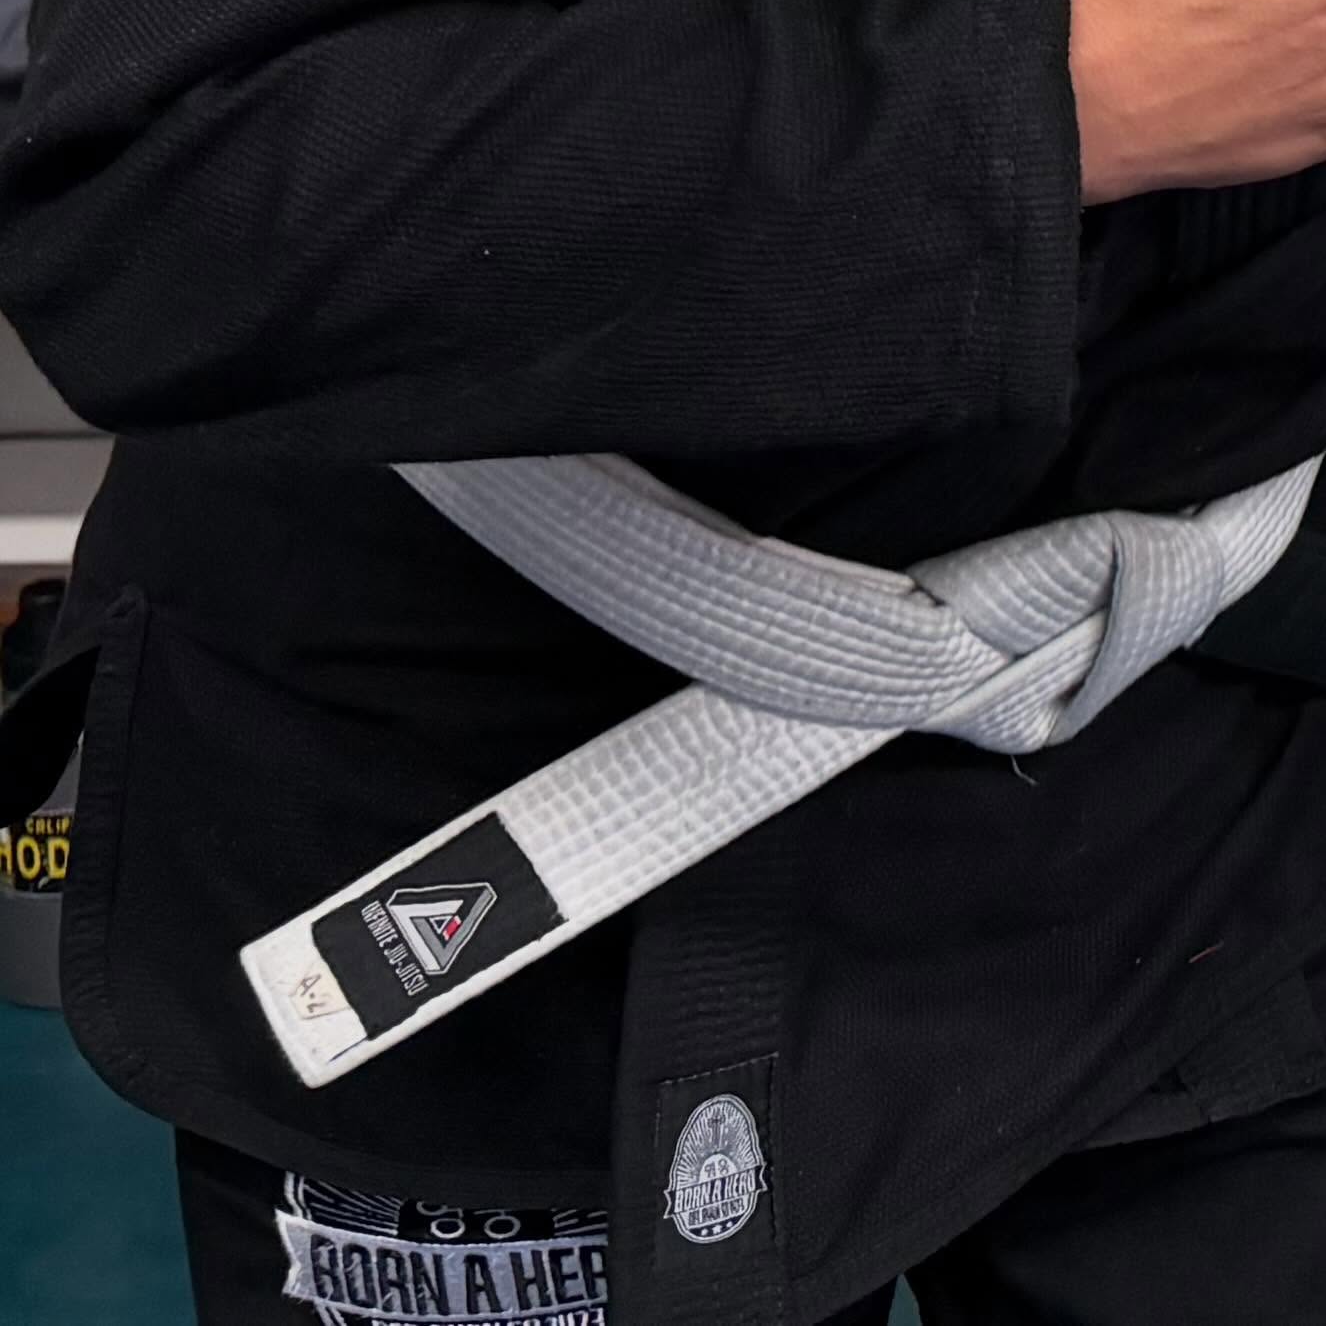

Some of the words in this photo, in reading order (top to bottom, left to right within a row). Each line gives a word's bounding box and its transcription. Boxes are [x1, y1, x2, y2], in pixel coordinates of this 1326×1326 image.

[383, 942, 430, 996] JIU-JITSU
[674, 1179, 711, 1214] BORN
[711, 1178, 723, 1204] A
[310, 1233, 451, 1316] BORN
[464, 1253, 501, 1315] A
[509, 1244, 607, 1312] HER
